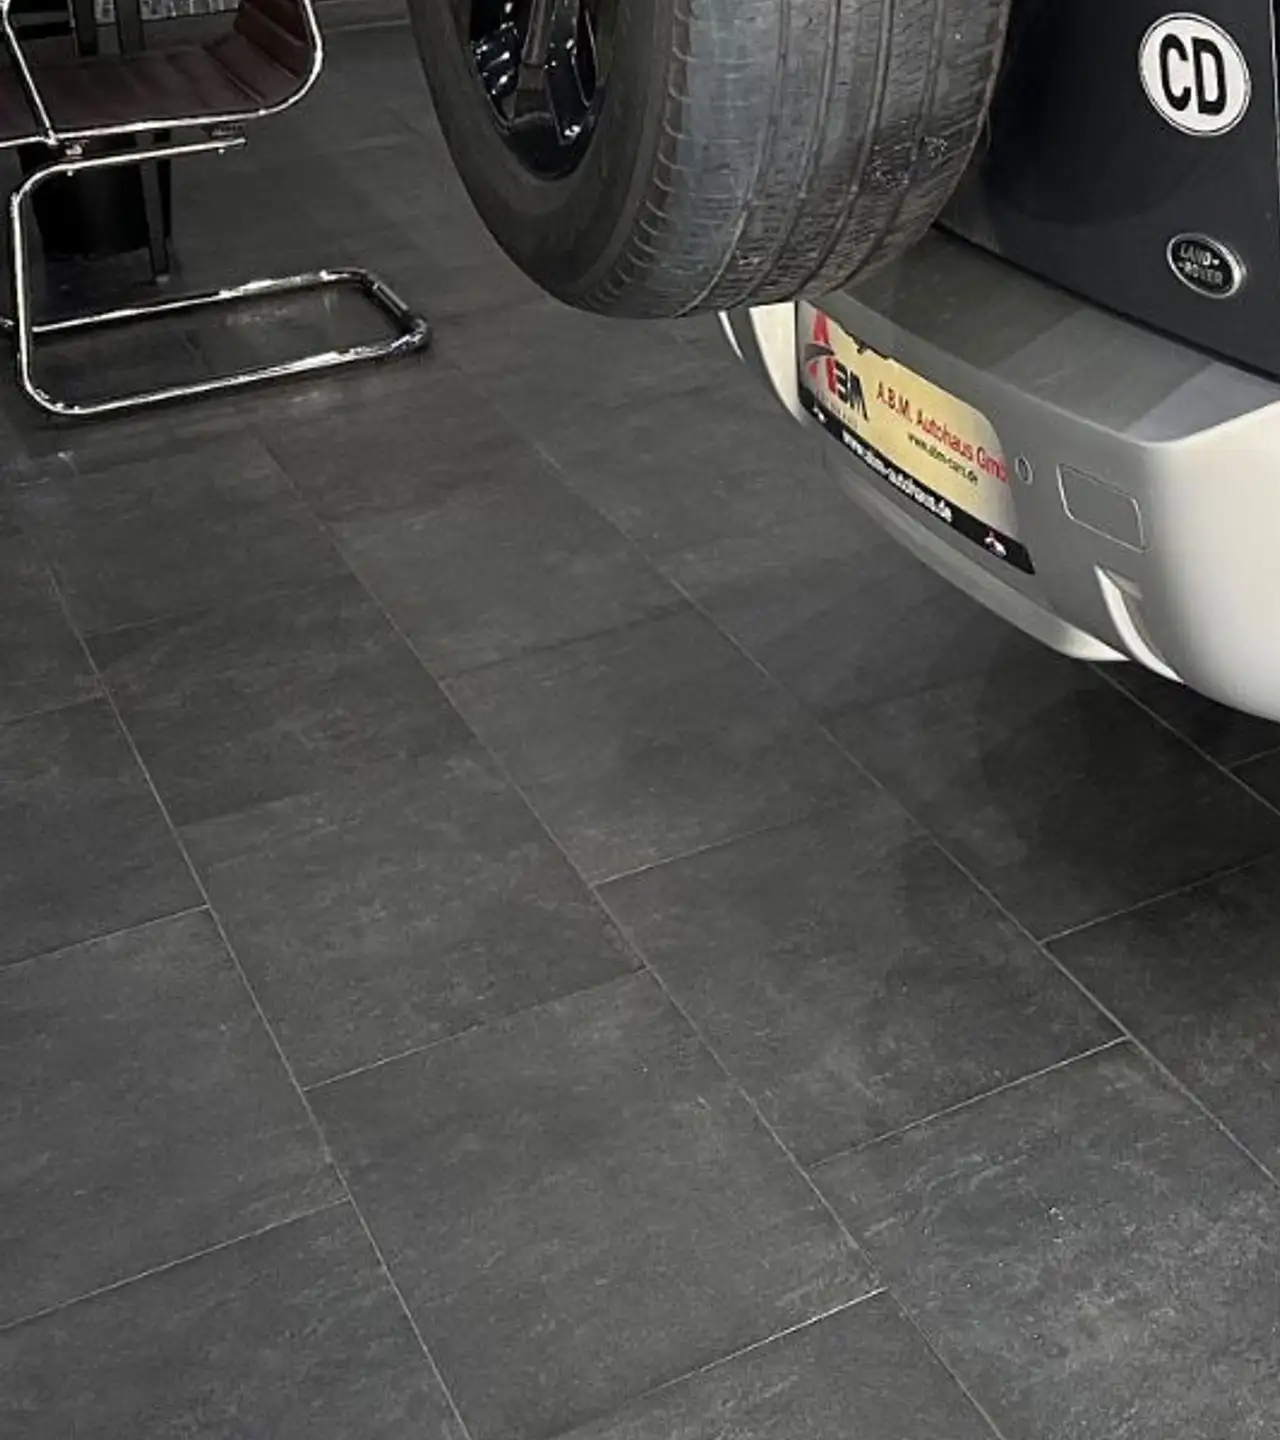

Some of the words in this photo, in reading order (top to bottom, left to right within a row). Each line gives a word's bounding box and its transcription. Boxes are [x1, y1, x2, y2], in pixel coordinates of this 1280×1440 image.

[1158, 33, 1227, 117] CD
[916, 408, 973, 462] Autohaus
[976, 445, 1010, 483] Gmb
